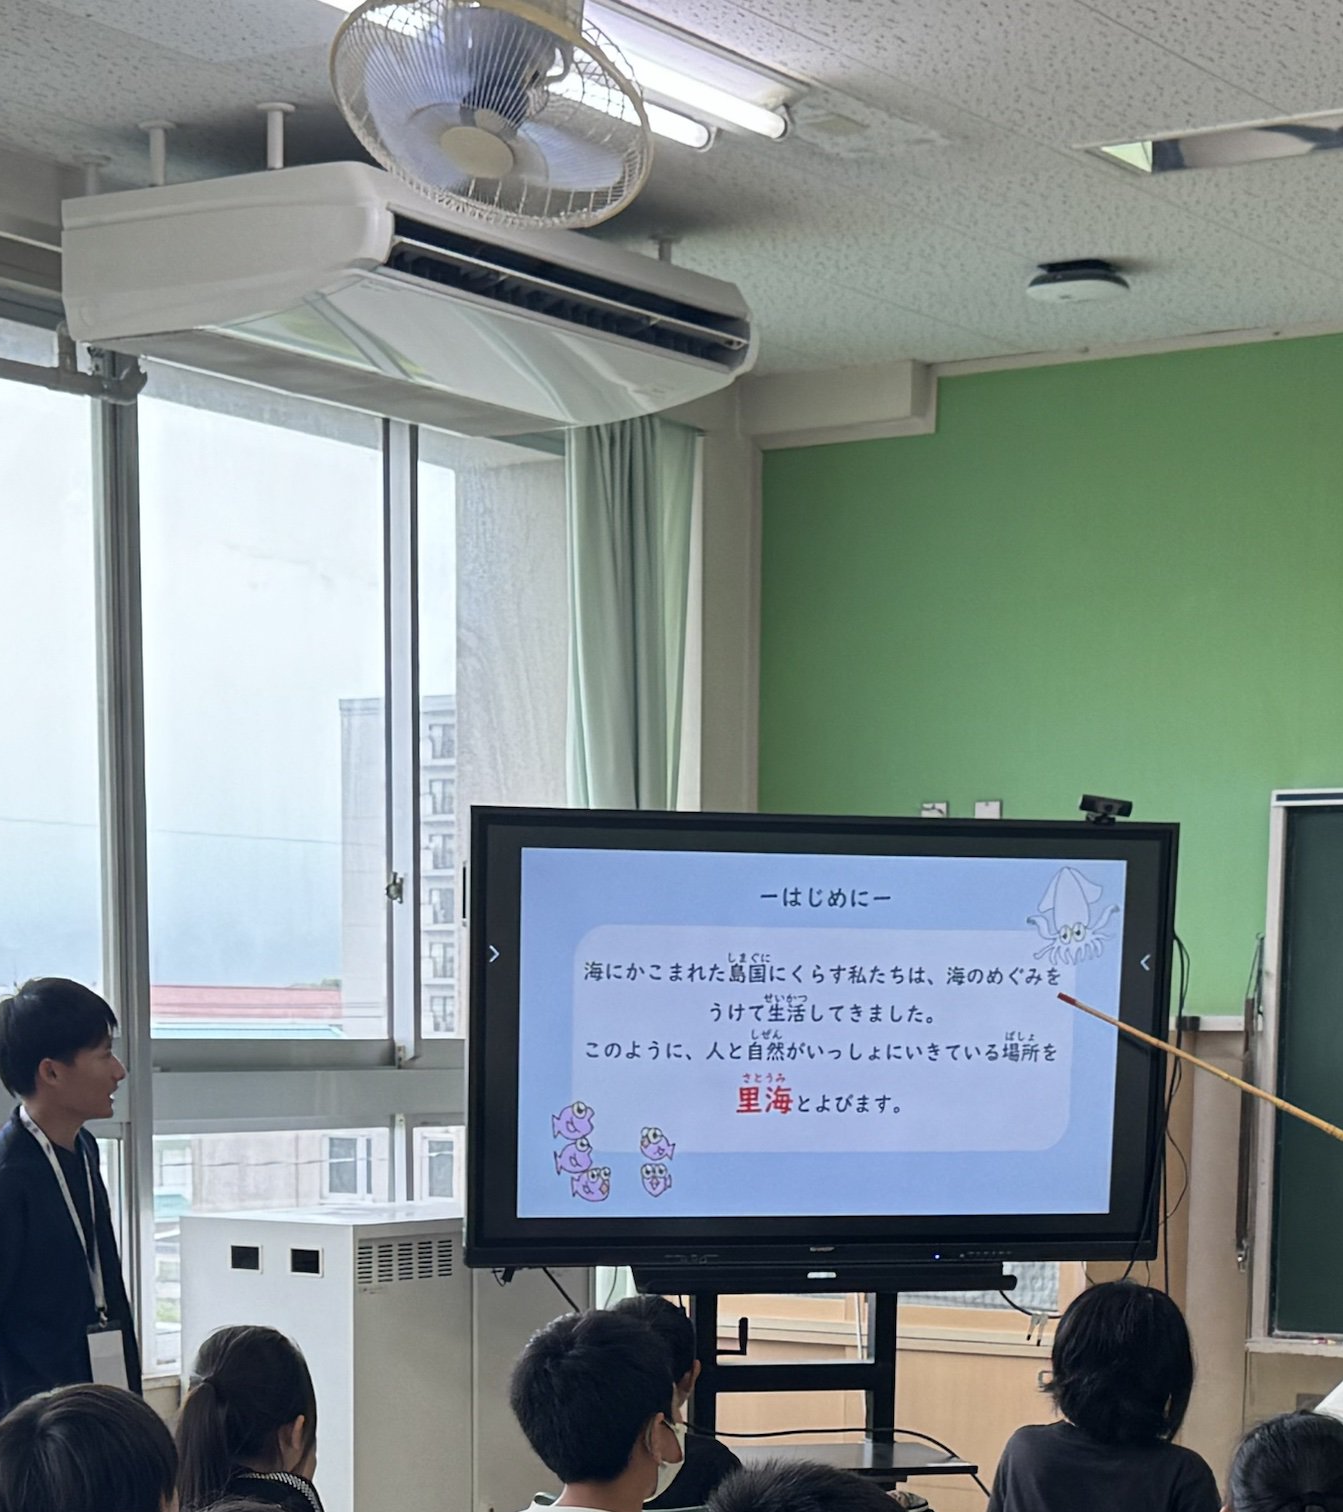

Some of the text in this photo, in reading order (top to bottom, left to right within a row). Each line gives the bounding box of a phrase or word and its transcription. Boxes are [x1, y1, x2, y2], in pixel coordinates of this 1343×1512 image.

[710, 1002, 934, 1024] うけて生活してきました。
[585, 1041, 1057, 1062] このように、人と自然がいっしょにいきている場所を
[736, 1086, 901, 1115] 里海とよびます。
